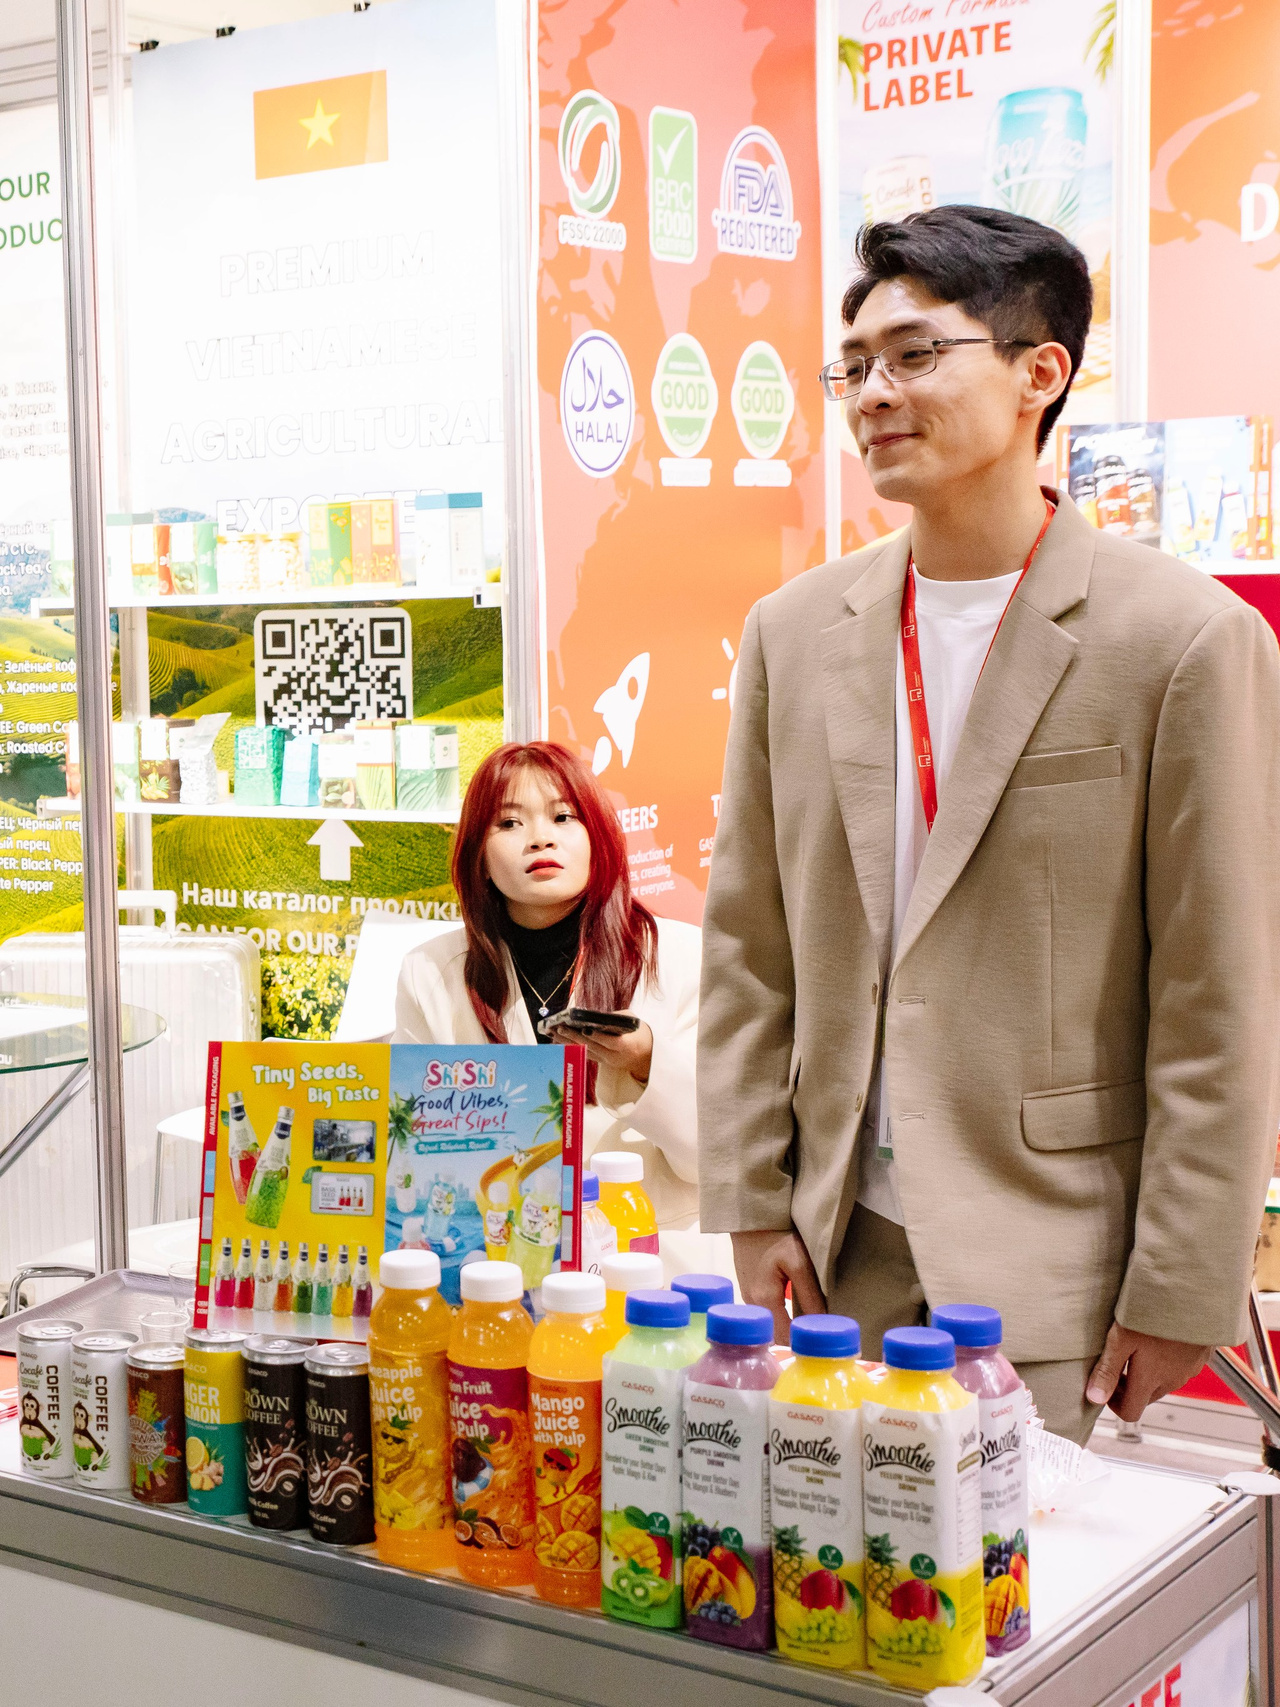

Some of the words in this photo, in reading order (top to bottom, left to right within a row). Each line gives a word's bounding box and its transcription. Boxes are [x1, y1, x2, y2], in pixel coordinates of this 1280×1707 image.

[863, 20, 1012, 73] PRIVATE
[864, 69, 973, 111] LABEL
[655, 177, 691, 211] BRC
[733, 165, 784, 217] FDA
[561, 220, 591, 242] FSSC
[593, 225, 624, 246] 22000
[655, 207, 692, 239] FOOD
[721, 217, 795, 255] REGISTERED
[220, 230, 434, 297] PREMIUM
[185, 313, 477, 381] VIETNAMESE
[571, 356, 624, 413] حلال
[660, 380, 709, 410] GOOD
[740, 385, 785, 414] GOOD
[161, 399, 505, 464] AGRICULTURAL
[575, 421, 623, 444] HALAL
[4, 659, 52, 673] Зелёные
[6, 680, 58, 694] Жареные
[16, 721, 51, 734] Green
[7, 741, 54, 755] Roasted
[18, 817, 62, 832] Чёрный
[16, 840, 51, 853] перец
[628, 848, 664, 865] roduction
[665, 844, 674, 858] of
[699, 837, 714, 852] GAS
[21, 857, 52, 871] Black
[54, 859, 83, 876] Pepp
[13, 877, 54, 894] Pepper
[182, 882, 237, 908] Наш
[243, 890, 344, 914] каталог
[287, 930, 339, 956] OUR
[211, 1057, 220, 1100] PACKAGING
[252, 1064, 295, 1090] Tiny
[300, 1062, 364, 1082] Seeds,
[566, 1063, 574, 1105] AVAILABLE
[308, 1087, 332, 1109] Big
[336, 1085, 380, 1103] Taste
[412, 1091, 455, 1113] Good
[460, 1093, 509, 1110] Vibes,
[208, 1100, 218, 1136] AVAILABLE
[411, 1112, 464, 1134] Great
[465, 1110, 508, 1132] Sips!
[565, 1106, 573, 1149] PACKAGING
[46, 1364, 61, 1421] COFFEE
[244, 1390, 290, 1412] ROWN
[462, 1381, 493, 1395] Fruit
[95, 1375, 109, 1432] COFFEE
[185, 1402, 220, 1424] EMON
[387, 1403, 423, 1423] Pulp
[450, 1394, 483, 1420] uice
[531, 1392, 585, 1415] Mango
[605, 1397, 670, 1435] Smoothie
[307, 1420, 339, 1438] OFFEE
[457, 1420, 490, 1441] Pulp
[534, 1411, 580, 1431] Juice
[879, 1416, 918, 1431] GASACO
[553, 1430, 586, 1448] Pulp
[771, 1428, 841, 1465] Smoothie
[864, 1433, 936, 1473] Smoothie
